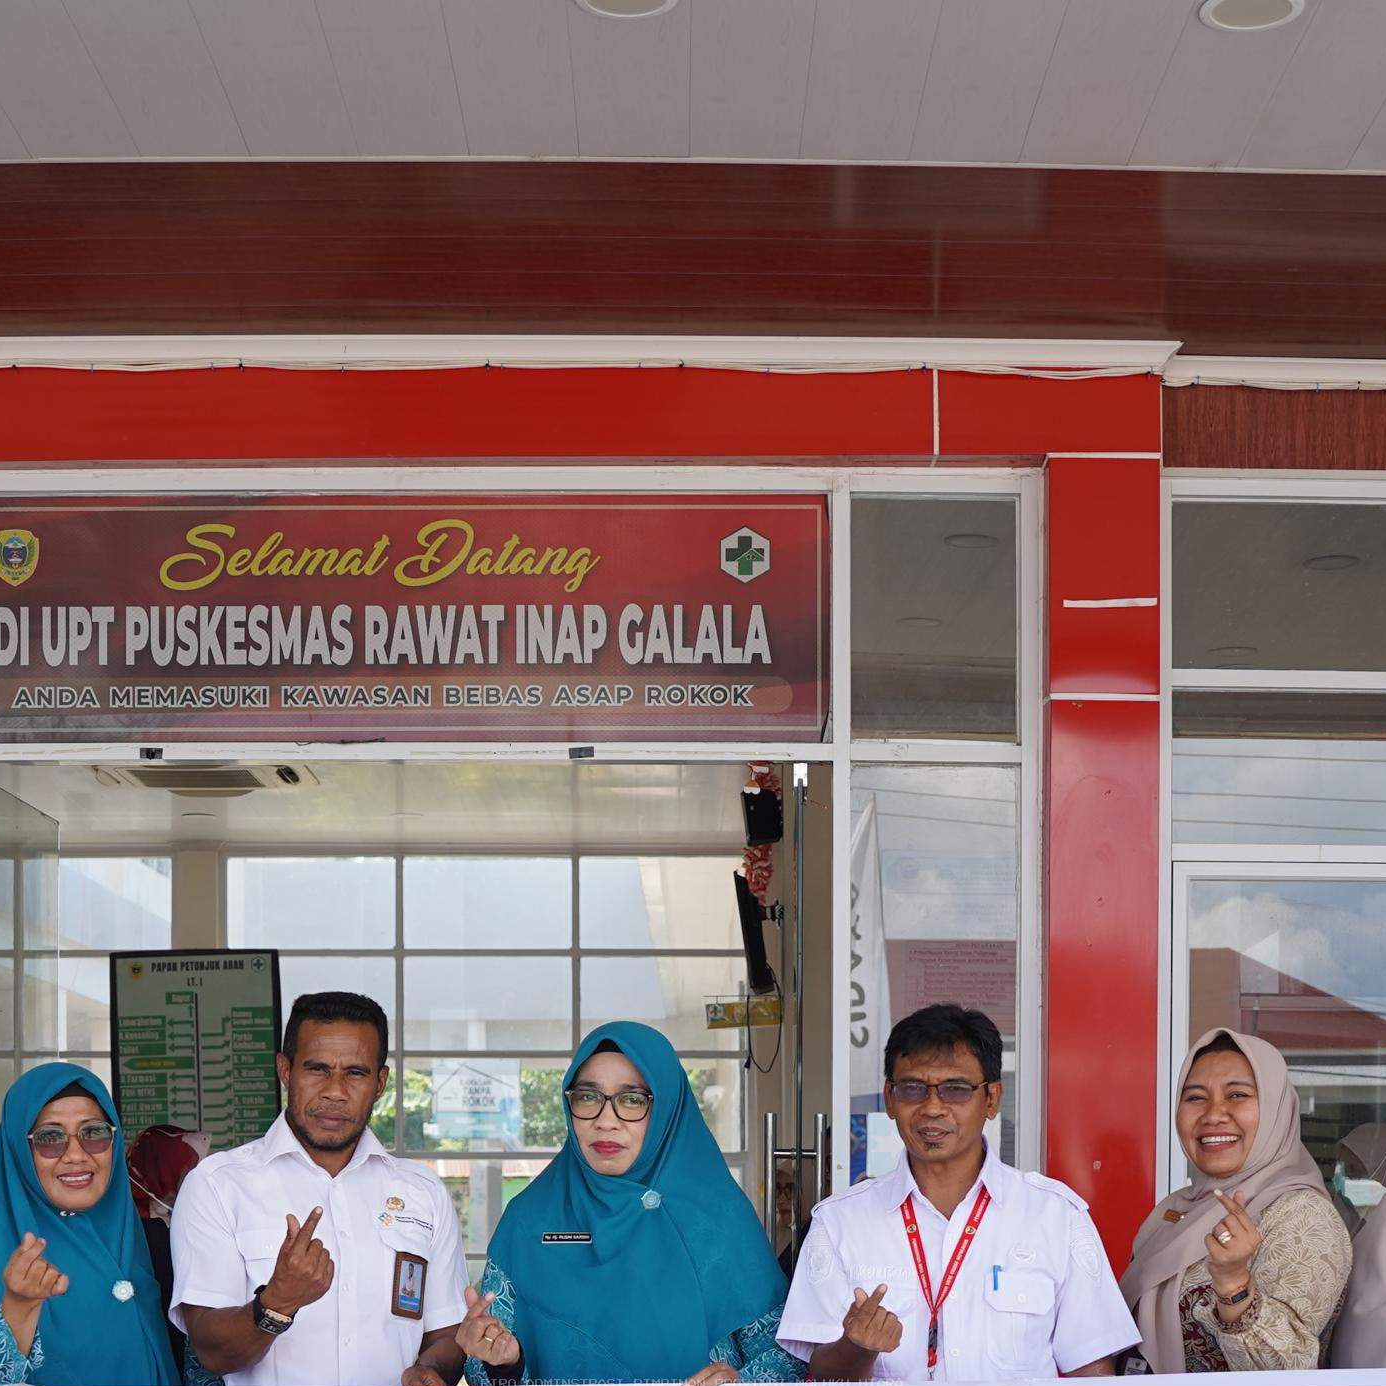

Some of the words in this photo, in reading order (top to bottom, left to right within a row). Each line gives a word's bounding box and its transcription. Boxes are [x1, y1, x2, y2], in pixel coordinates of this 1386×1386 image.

[159, 522, 388, 591] Selamat
[394, 519, 601, 592] Datang
[41, 606, 116, 666] UPT
[126, 605, 354, 666] PUSKESMAS
[364, 604, 506, 665] RAWAT
[515, 604, 609, 665] INAP
[618, 604, 772, 665] GALALA
[11, 686, 98, 709] ANDA
[110, 685, 270, 708] MEMASUKI
[281, 685, 431, 707] KAWASAN
[443, 684, 542, 706] BEBAS
[552, 684, 633, 707] ASAP
[645, 683, 753, 706] ROKOK
